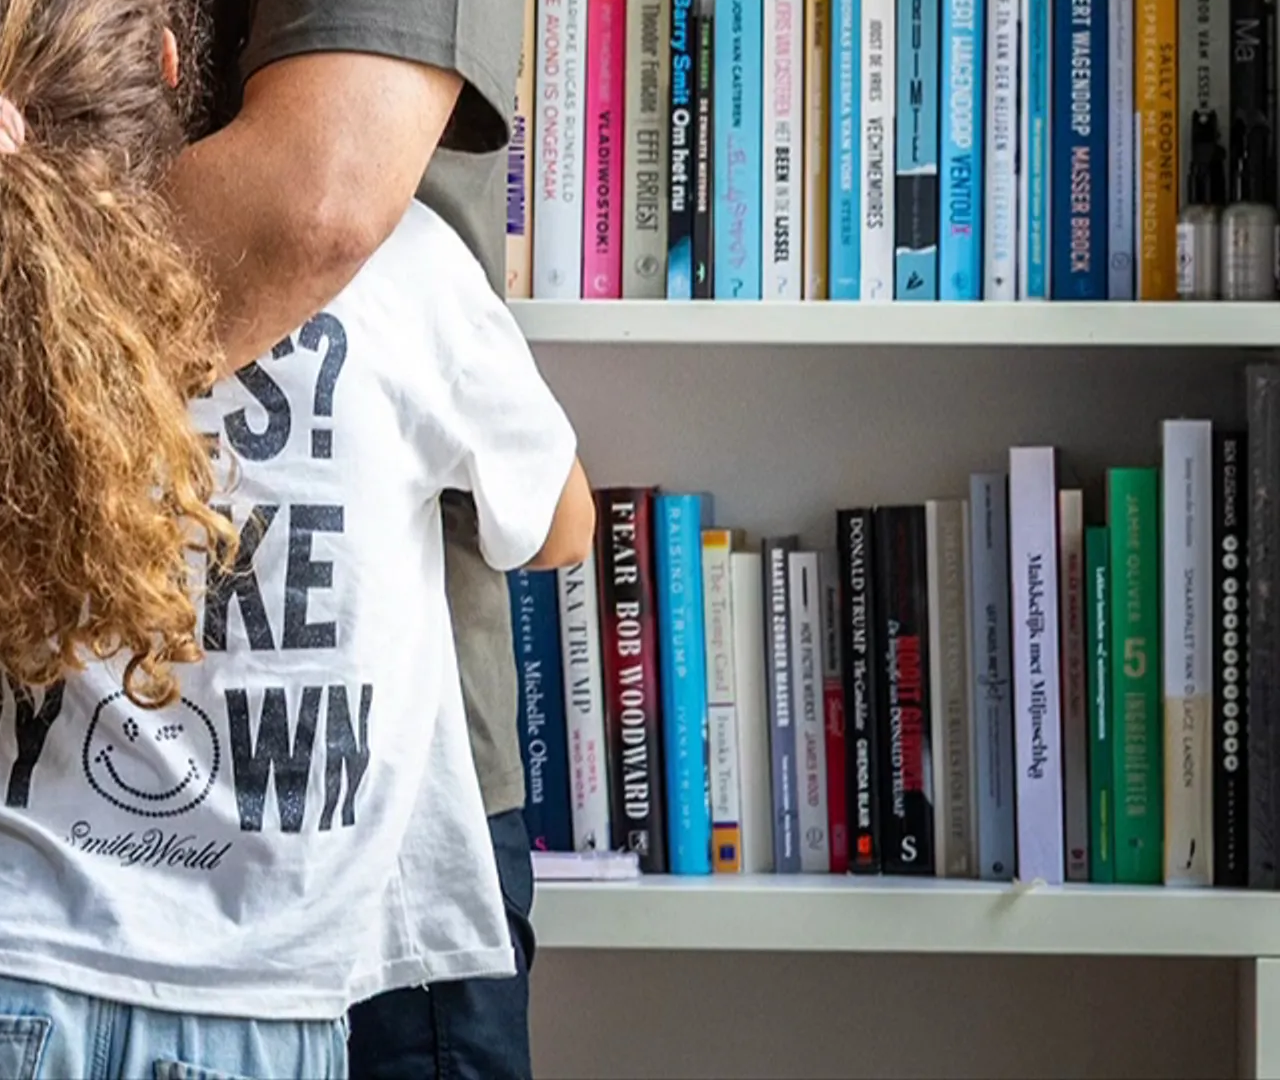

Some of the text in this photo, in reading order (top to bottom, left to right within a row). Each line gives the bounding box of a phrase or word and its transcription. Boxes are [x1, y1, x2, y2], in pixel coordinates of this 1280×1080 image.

[544, 14, 561, 76] AVOND
[564, 59, 578, 109] LUCAS
[672, 55, 691, 104] Smit
[731, 0, 742, 128] JORIS VAN CASTEREN
[1071, 31, 1091, 136] WAGENDORP
[1235, 18, 1260, 63] Ma
[544, 83, 560, 100] IS
[671, 109, 689, 146] Om
[1159, 43, 1173, 193] SALLY ROONEY
[543, 106, 560, 201] ONGEMAK
[562, 115, 578, 202] RIJNEVELD
[596, 110, 611, 254] VLADIWOSTOK!
[671, 149, 689, 181] het
[671, 185, 687, 210] nu
[775, 147, 790, 182] BEEN
[866, 117, 884, 229] VECHTMEMOIRES
[1071, 146, 1090, 213] MASSER
[1070, 217, 1090, 272] BROCK
[201, 312, 349, 461] S?
[849, 517, 866, 653] DONALD TRUMP
[568, 621, 592, 715] TRUMP
[611, 502, 650, 819] FEAR BOB WOODWARD
[669, 507, 691, 830] RAISING TRUMP IVANA TRUMP
[1025, 553, 1047, 780] Makkelijk met Miljuschka
[523, 660, 547, 803] Michelle Obama
[65, 821, 234, 871] SmileyWorld
